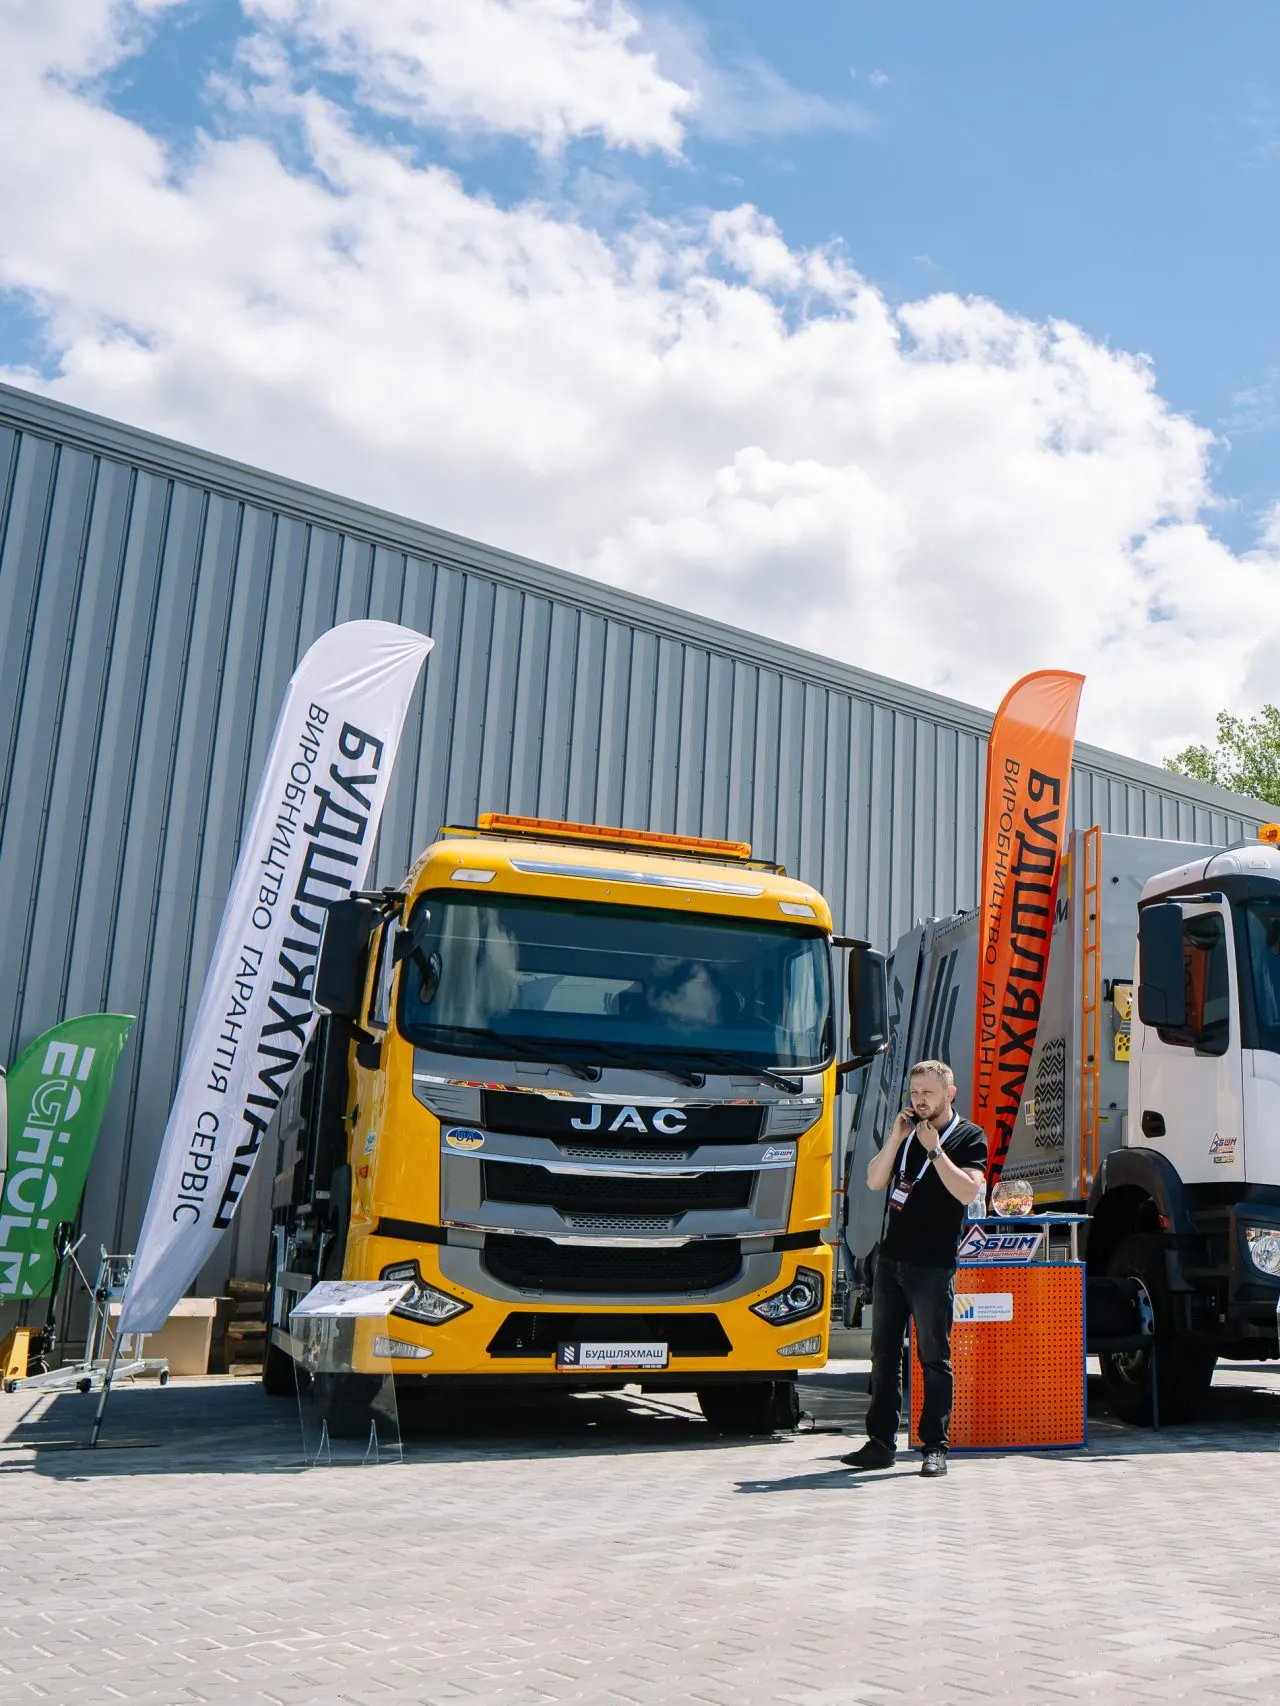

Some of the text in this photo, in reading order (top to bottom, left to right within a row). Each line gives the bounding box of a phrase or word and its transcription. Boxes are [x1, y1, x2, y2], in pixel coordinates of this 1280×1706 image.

[985, 757, 1020, 965] ВИРОБНИЦТВО
[172, 702, 330, 1225] ВИРОБНИЦТВО ГАРАНТІЯ СЕРВІС
[570, 1104, 688, 1135] JAC
[456, 1131, 474, 1142] UA
[0, 1041, 96, 1296] EGHOLM
[984, 1237, 1035, 1250] БШМ
[585, 1349, 663, 1360] БУДШЛЯХМАШ
